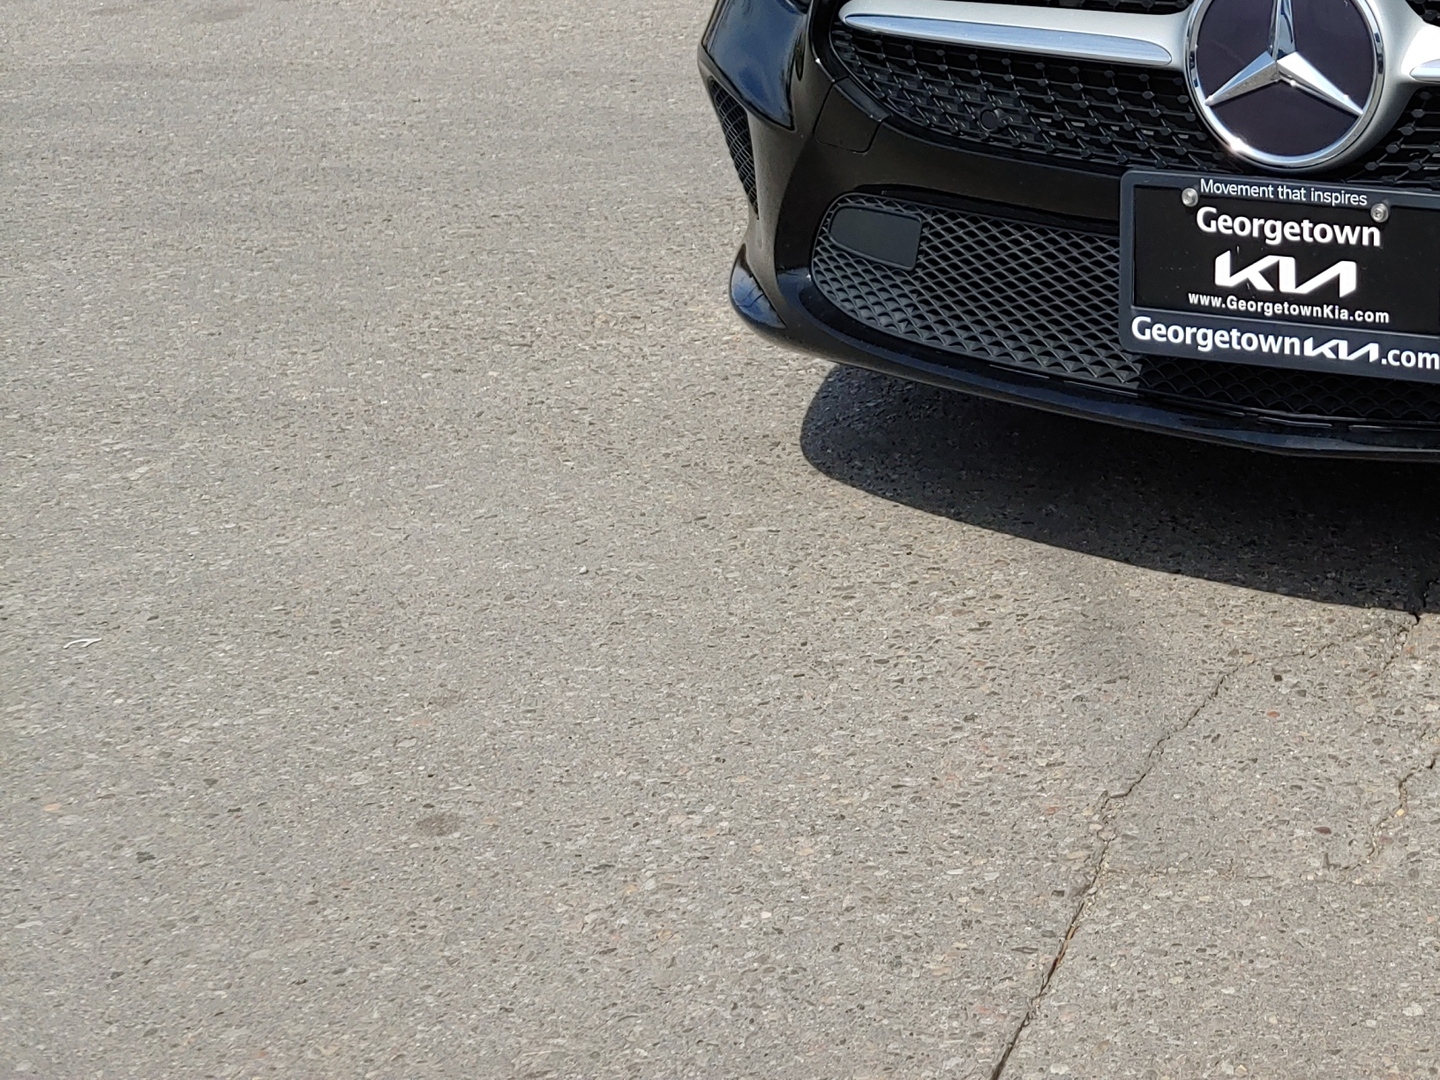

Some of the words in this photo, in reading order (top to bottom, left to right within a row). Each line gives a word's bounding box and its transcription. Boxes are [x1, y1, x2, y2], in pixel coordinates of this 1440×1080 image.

[1200, 178, 1274, 199] Movement
[1278, 185, 1306, 201] that
[1310, 188, 1368, 207] inspires
[1196, 206, 1382, 247] Georgetown
[1215, 250, 1357, 298] KIA
[1188, 292, 1390, 324] www.GeorgetownKia.com
